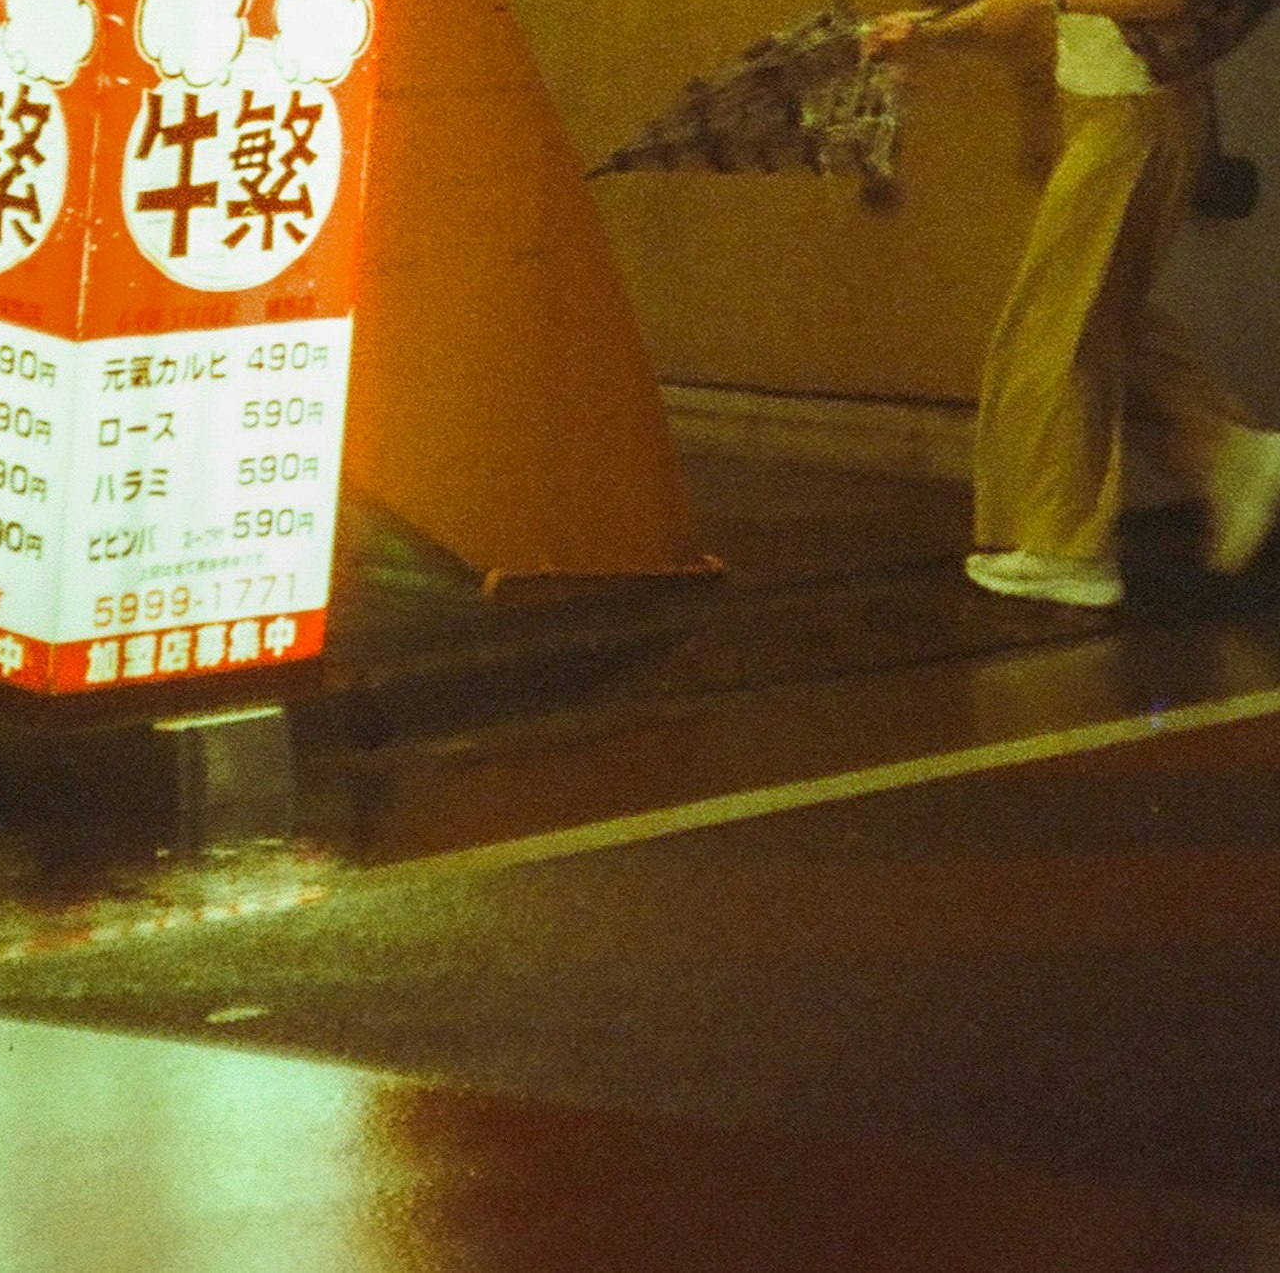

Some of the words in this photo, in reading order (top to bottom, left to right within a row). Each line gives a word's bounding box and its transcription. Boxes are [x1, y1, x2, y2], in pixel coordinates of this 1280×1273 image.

[135, 88, 324, 258] 牛繁
[246, 341, 329, 373] 490円
[98, 411, 176, 448] ロース
[241, 396, 324, 429] 590円
[92, 467, 169, 504] ハラミ
[237, 452, 320, 486] 590円
[233, 507, 316, 540] 590円
